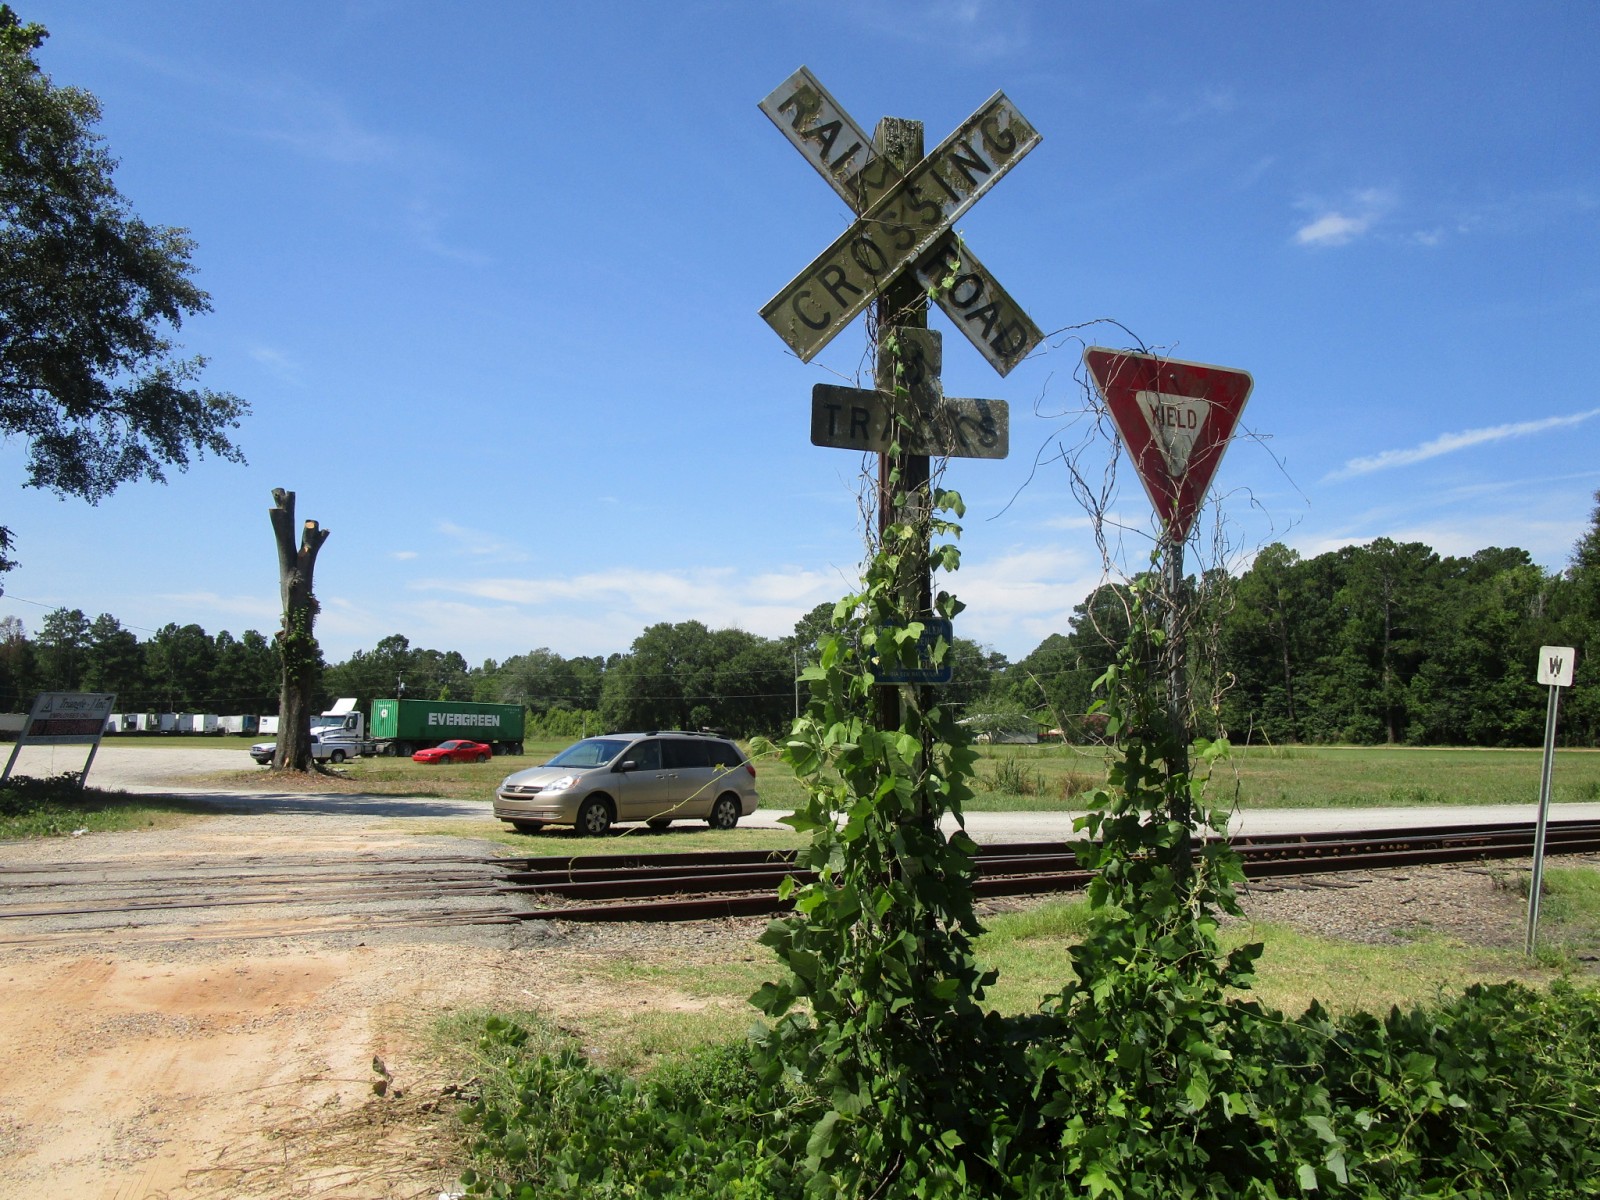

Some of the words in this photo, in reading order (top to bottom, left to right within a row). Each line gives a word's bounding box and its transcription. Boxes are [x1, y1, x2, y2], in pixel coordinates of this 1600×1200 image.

[777, 84, 879, 199] RAIL
[791, 116, 1017, 331] CROSSING
[921, 245, 1029, 357] ROAD
[1150, 404, 1198, 430] YIELD
[1549, 657, 1563, 675] W
[428, 713, 500, 727] EVERGREEN
